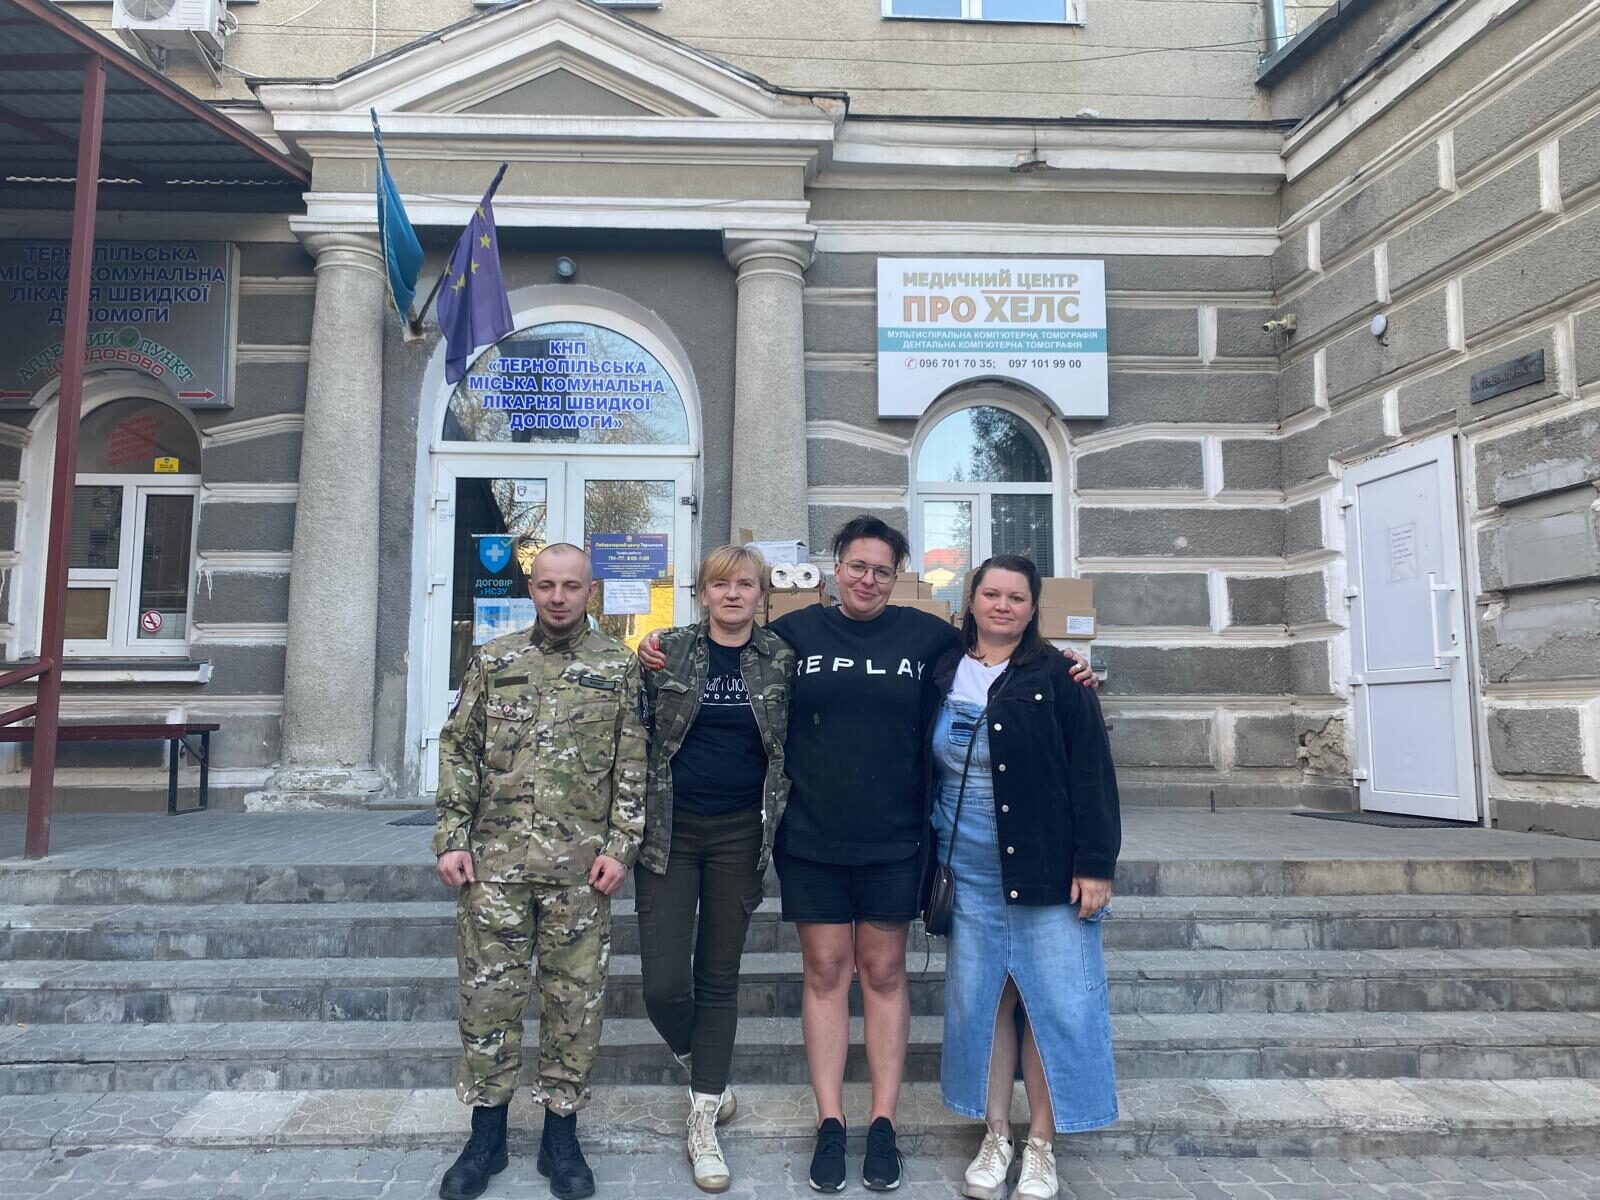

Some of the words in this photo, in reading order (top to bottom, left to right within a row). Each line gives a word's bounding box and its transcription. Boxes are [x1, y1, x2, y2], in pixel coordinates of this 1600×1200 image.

[24, 245, 198, 261] ТЕРНПІЛЬСЬКА
[903, 270, 1011, 289] МЕДИЧНИЙ
[1017, 273, 1079, 289] ЦЕНТР
[8, 285, 100, 302] ЛІКАРЯ
[108, 285, 209, 304] ШВИДКОЇ
[48, 307, 170, 324] ДОМОГИ
[903, 295, 976, 323] ПРО
[984, 296, 1080, 323] ХЕЛС
[887, 330, 971, 339] МУЛЬТИСПІРАЛЬНА
[1041, 331, 1098, 340] ТОМОГРАФІЯ
[549, 340, 586, 356] КНП
[902, 340, 956, 350] ДЕНТАЛЬНА
[1025, 341, 1083, 350] ТОМОГРАФІЯ
[17, 329, 115, 382] АПТЕИЙ
[138, 337, 195, 383] ПУНКТ
[919, 359, 939, 368] 096
[942, 359, 959, 368] 701
[964, 359, 976, 368] 70
[980, 359, 996, 370] 35;
[1009, 359, 1027, 368] 097
[1031, 359, 1050, 368] 101
[1053, 359, 1066, 368] 99
[1068, 359, 1082, 368] 00
[488, 358, 647, 375] «ТЕРНОПІЛЬСЬКА
[469, 376, 537, 392] МІСЬКА
[541, 378, 665, 394] КОМУНАЛЬНА
[482, 395, 560, 410] ЛІКАРНЯ
[567, 395, 651, 413] ШВИДКОЇ
[510, 414, 623, 430] ДОПОМОГИ»
[475, 579, 513, 588] ДОГОВІР
